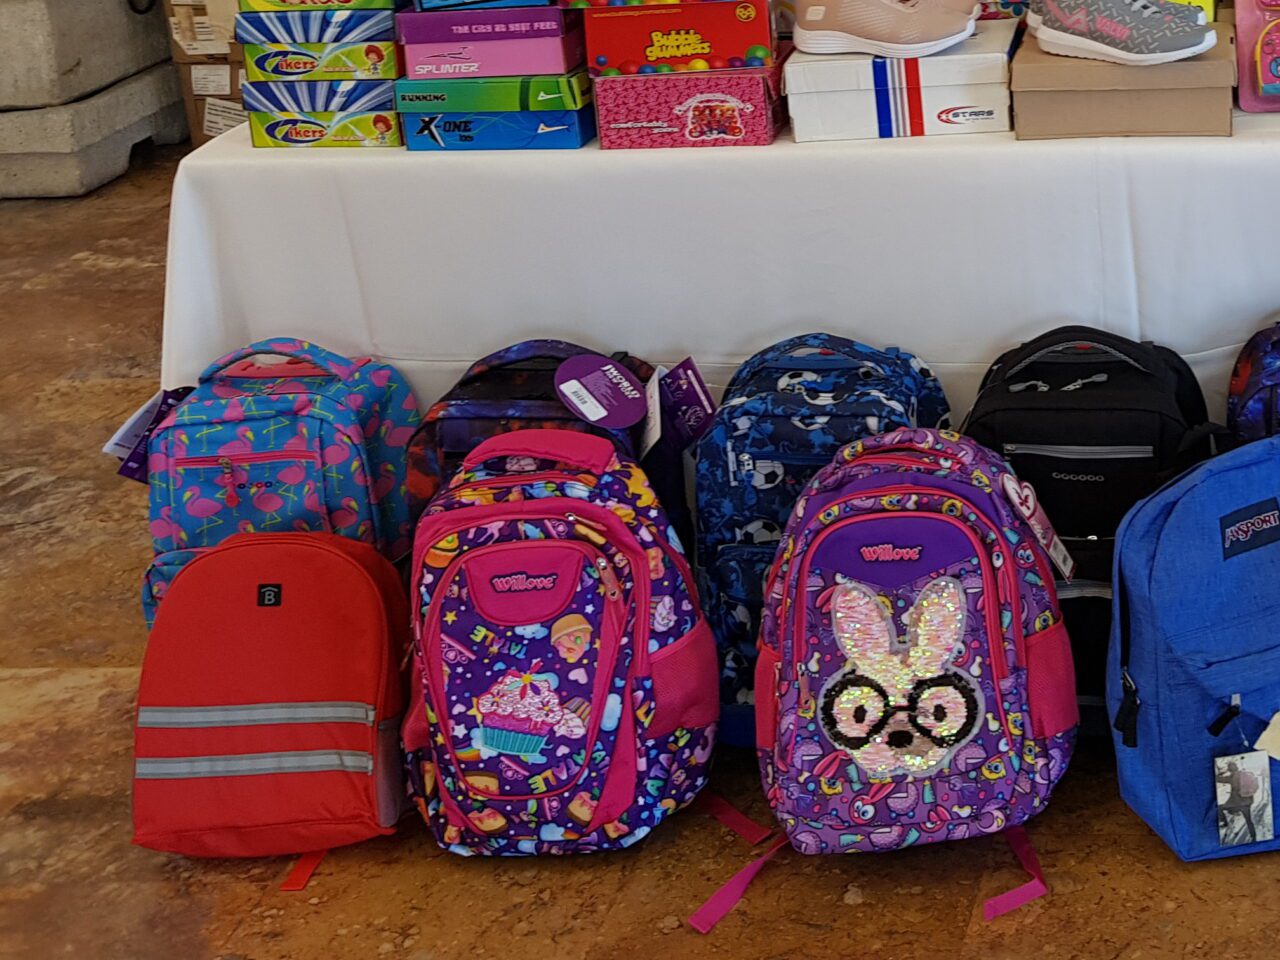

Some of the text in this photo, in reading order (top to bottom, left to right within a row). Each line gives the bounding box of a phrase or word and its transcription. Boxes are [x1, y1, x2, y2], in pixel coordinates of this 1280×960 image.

[651, 29, 702, 46] Bubble
[645, 42, 711, 61] gummers
[414, 62, 481, 75] SPLINTER
[400, 93, 447, 102] RUNNING
[952, 110, 995, 119] STARS
